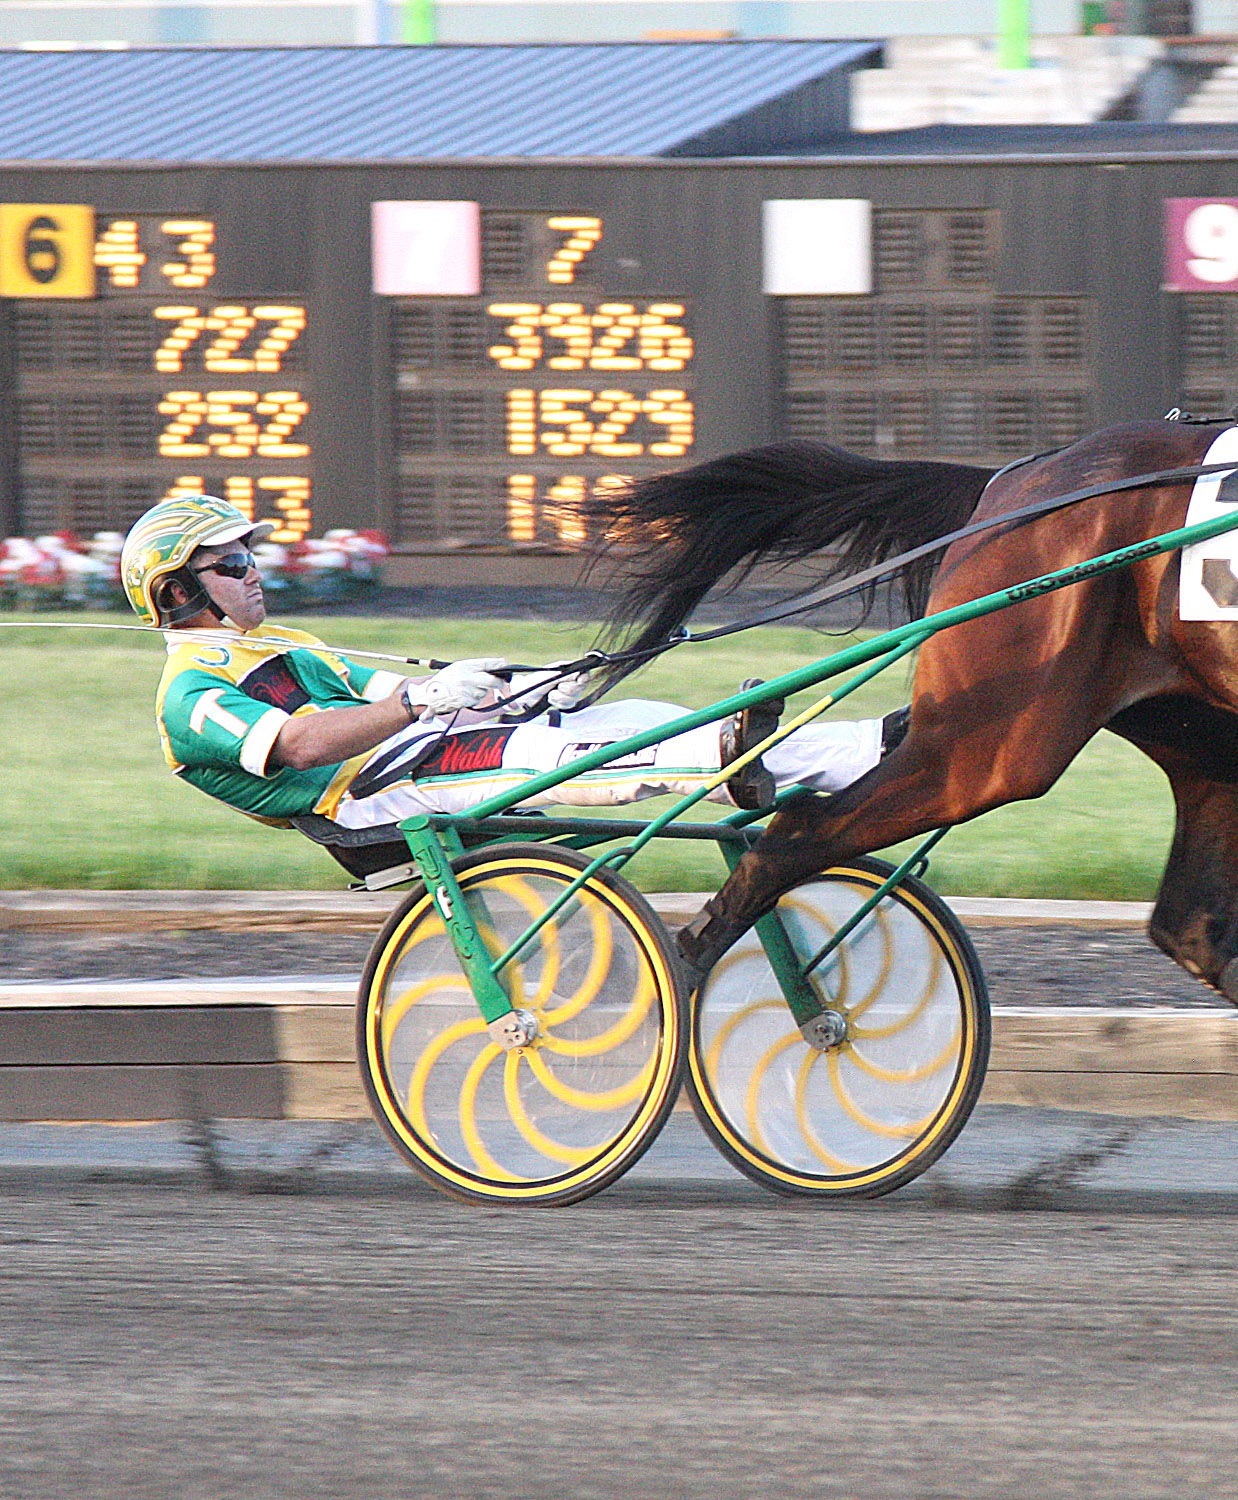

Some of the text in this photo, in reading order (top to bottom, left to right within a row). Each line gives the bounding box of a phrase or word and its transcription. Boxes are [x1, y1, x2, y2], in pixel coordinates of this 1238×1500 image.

[24, 216, 61, 284] 6
[547, 217, 600, 284] 7
[155, 306, 305, 372] 727
[488, 303, 693, 370] 3926
[158, 391, 310, 457] 252
[508, 389, 693, 456] 1529
[423, 731, 507, 773] Walsh
